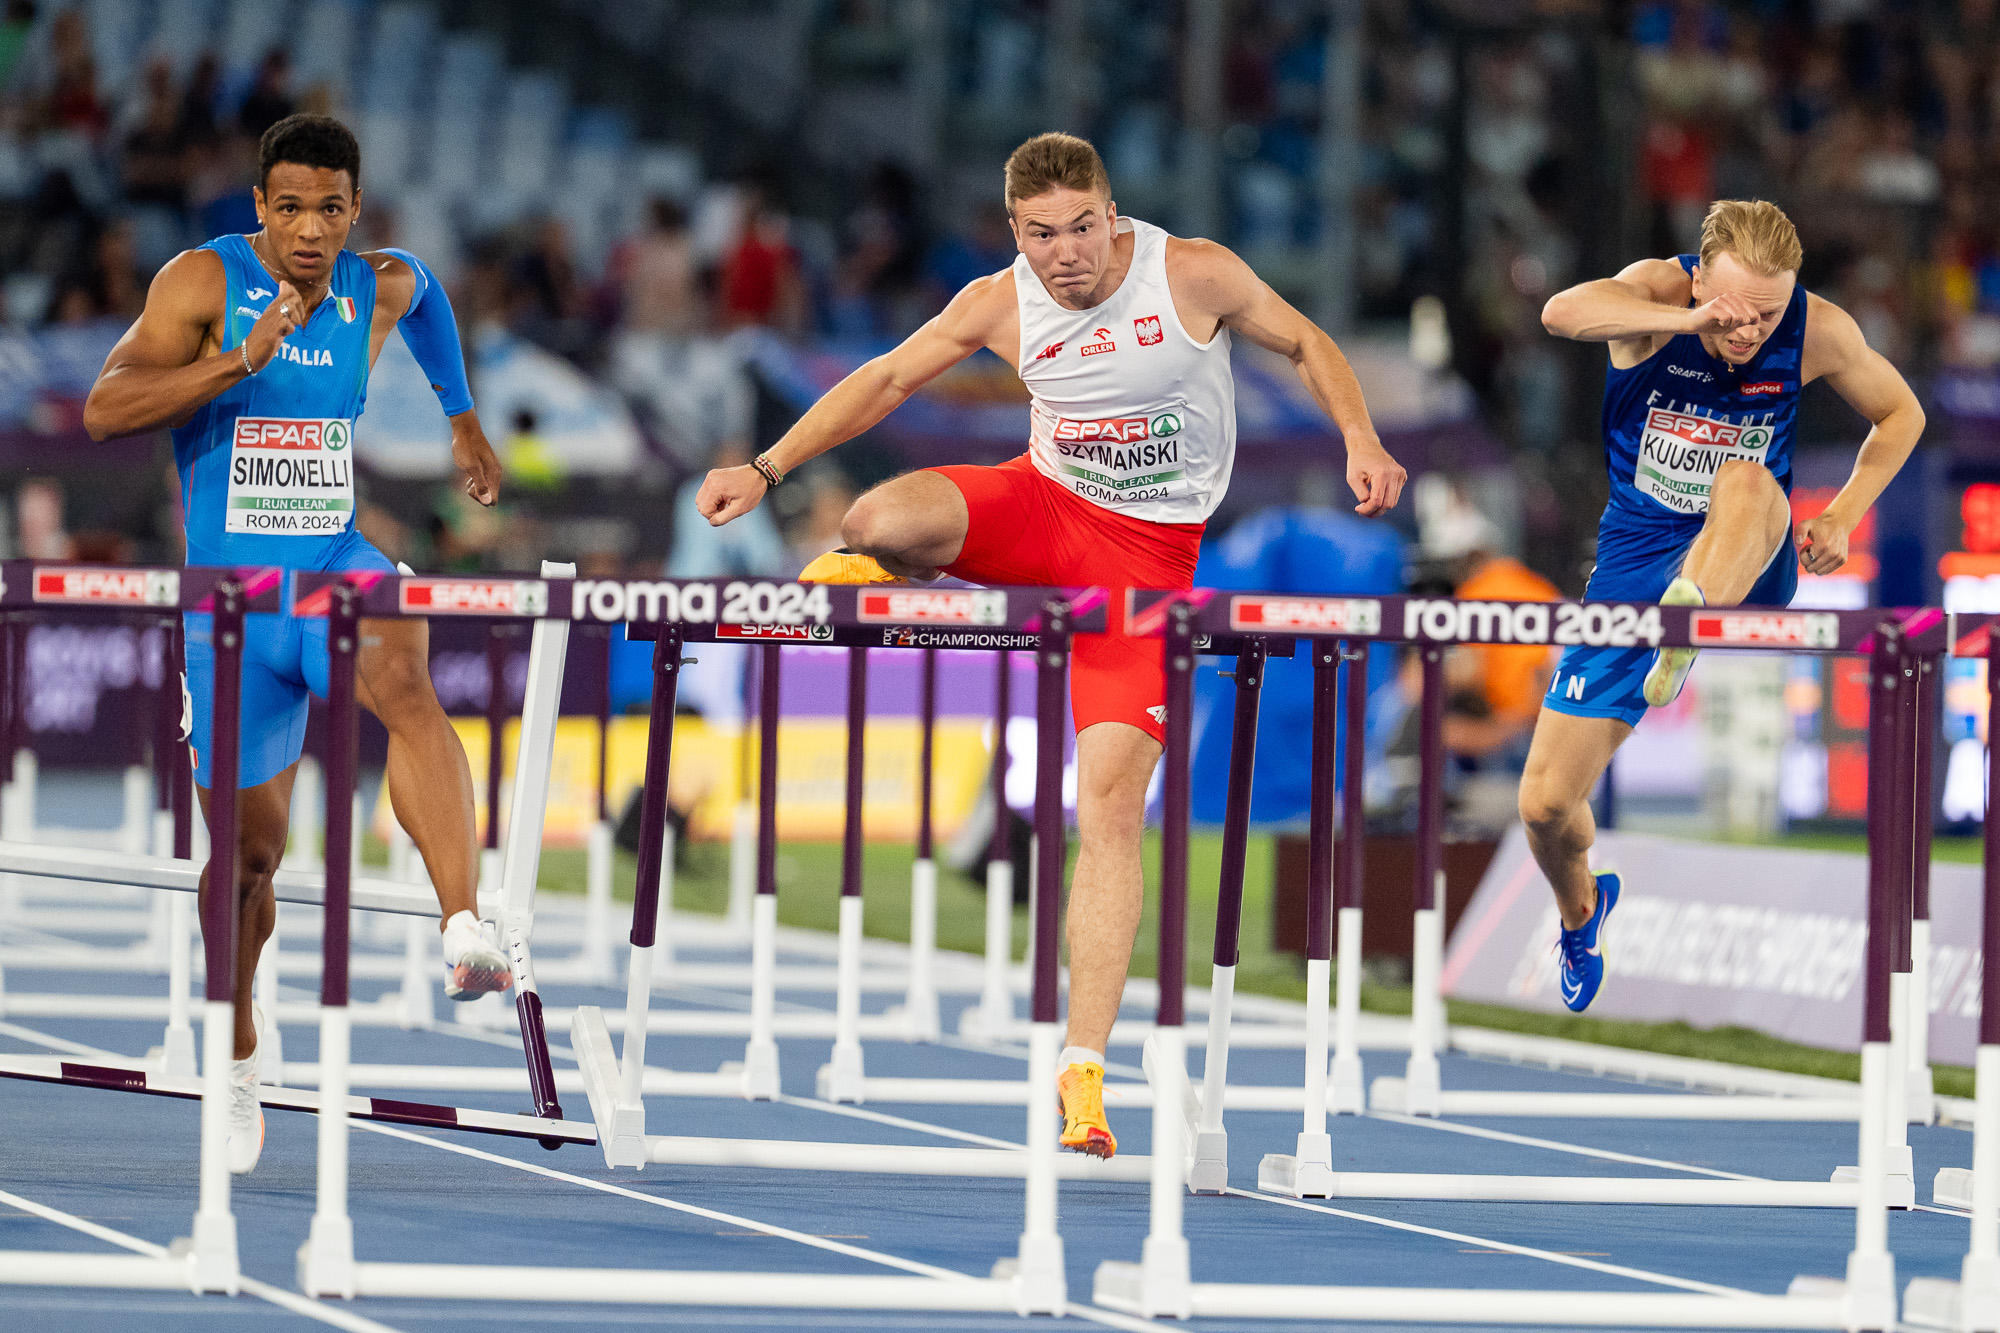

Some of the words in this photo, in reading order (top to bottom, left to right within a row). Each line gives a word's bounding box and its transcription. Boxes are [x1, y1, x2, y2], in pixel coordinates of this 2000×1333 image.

[275, 342, 334, 367] TALIA
[1082, 342, 1114, 356] ORLEN
[1667, 364, 1704, 381] CRAFT
[238, 423, 320, 447] SPAR
[1056, 421, 1146, 442] SPAR
[1651, 414, 1741, 445] SPAR
[1057, 440, 1178, 471] SZYMAŃSKI
[233, 456, 349, 488] SIMONELLI
[1083, 470, 1088, 479] I
[1089, 472, 1113, 488] RUN
[1076, 481, 1123, 502] ROMA
[1128, 487, 1169, 501] 2024
[1659, 475, 1663, 483] I
[1664, 479, 1688, 493] RUN
[1689, 483, 1711, 495] CLE
[256, 498, 261, 509] I
[262, 498, 288, 510] RUN
[1652, 483, 1694, 511] ROMA
[246, 514, 298, 529] ROMA
[301, 515, 341, 530] 2024
[64, 570, 146, 599] SPAR
[430, 582, 514, 608] SPAR
[572, 581, 716, 622] roma
[722, 582, 832, 624] 2024
[888, 591, 973, 619] SPAR
[740, 623, 807, 636] SPAR
[1260, 602, 1346, 629] SPAR
[1403, 601, 1549, 643] roma
[1554, 602, 1664, 647] 2024
[1721, 612, 1806, 641] SPAR
[918, 633, 1042, 647] CHAMPIONSHIPS
